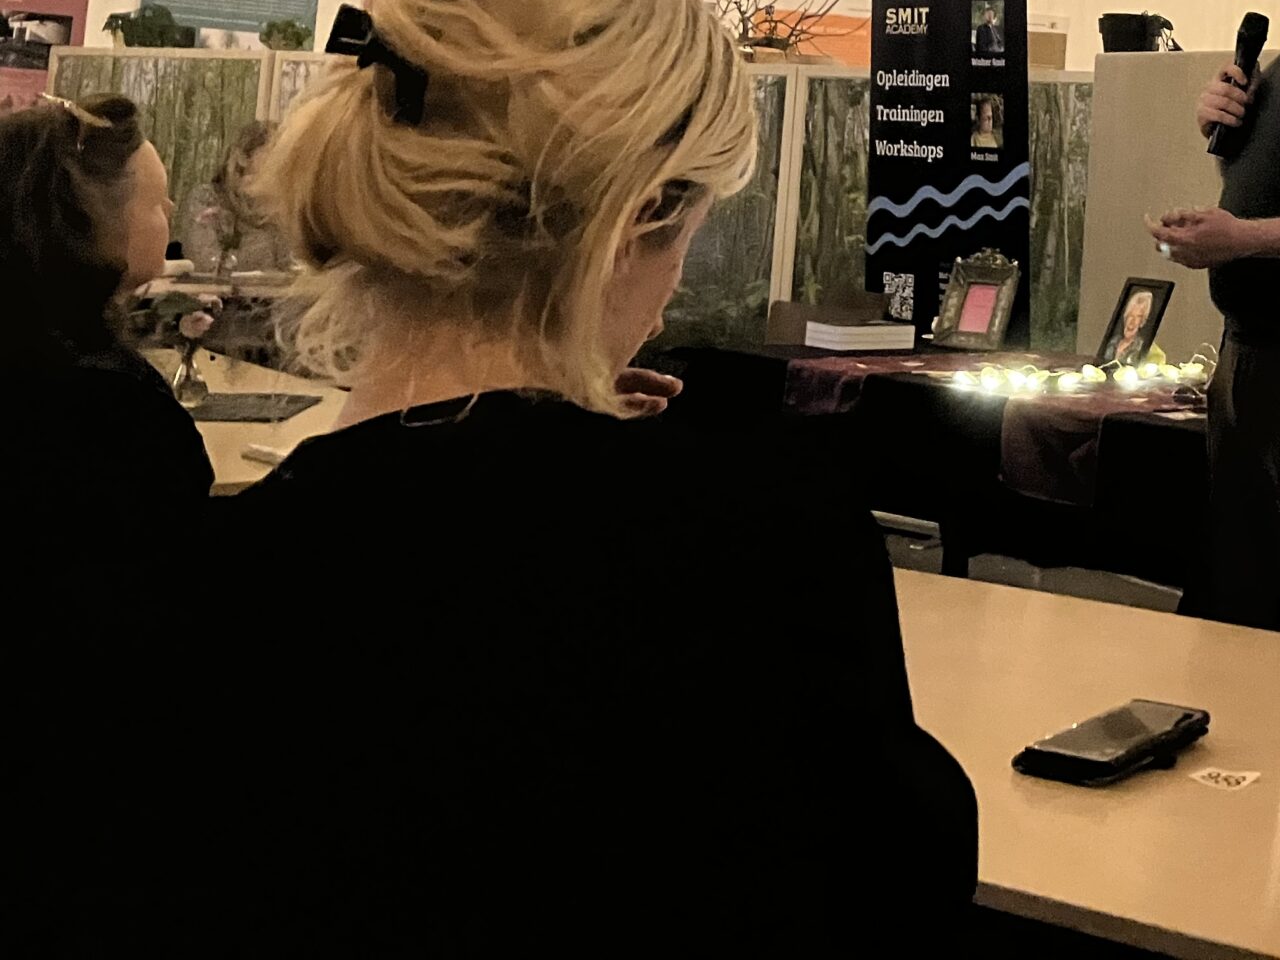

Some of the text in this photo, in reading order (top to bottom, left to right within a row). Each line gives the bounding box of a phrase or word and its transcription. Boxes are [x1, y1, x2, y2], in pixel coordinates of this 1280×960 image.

[885, 7, 930, 24] SMIT
[885, 24, 928, 35] ACADEMY
[876, 69, 950, 91] Opleidingen
[875, 105, 944, 127] Trainingen
[875, 140, 944, 162] Workshops
